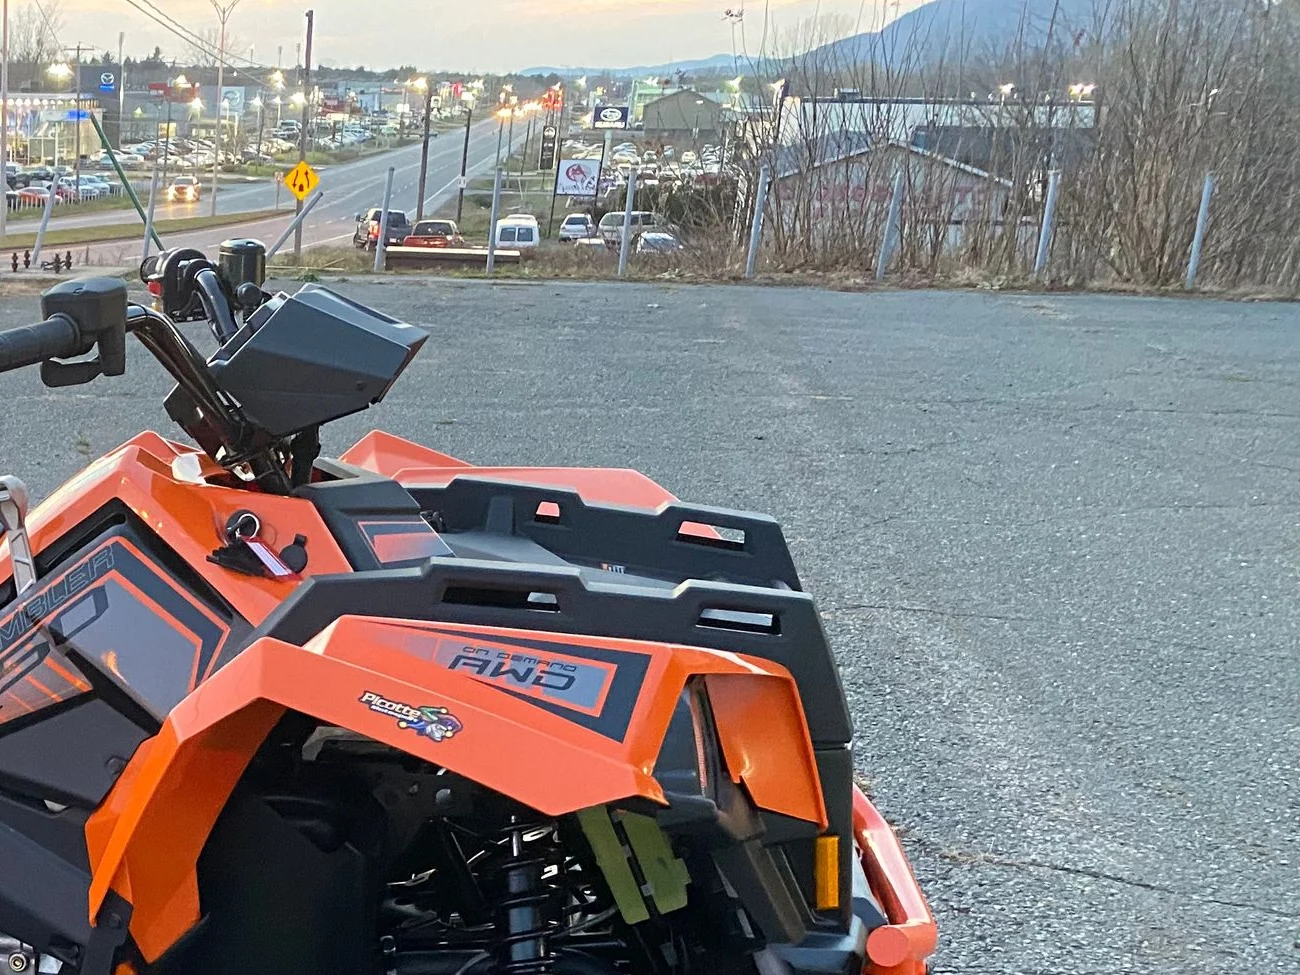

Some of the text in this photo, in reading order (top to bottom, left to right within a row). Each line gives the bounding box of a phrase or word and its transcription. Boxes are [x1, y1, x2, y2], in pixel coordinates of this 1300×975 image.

[447, 655, 577, 691] AWD
[462, 645, 578, 673] ON DEMAND
[360, 692, 422, 719] Picotte
